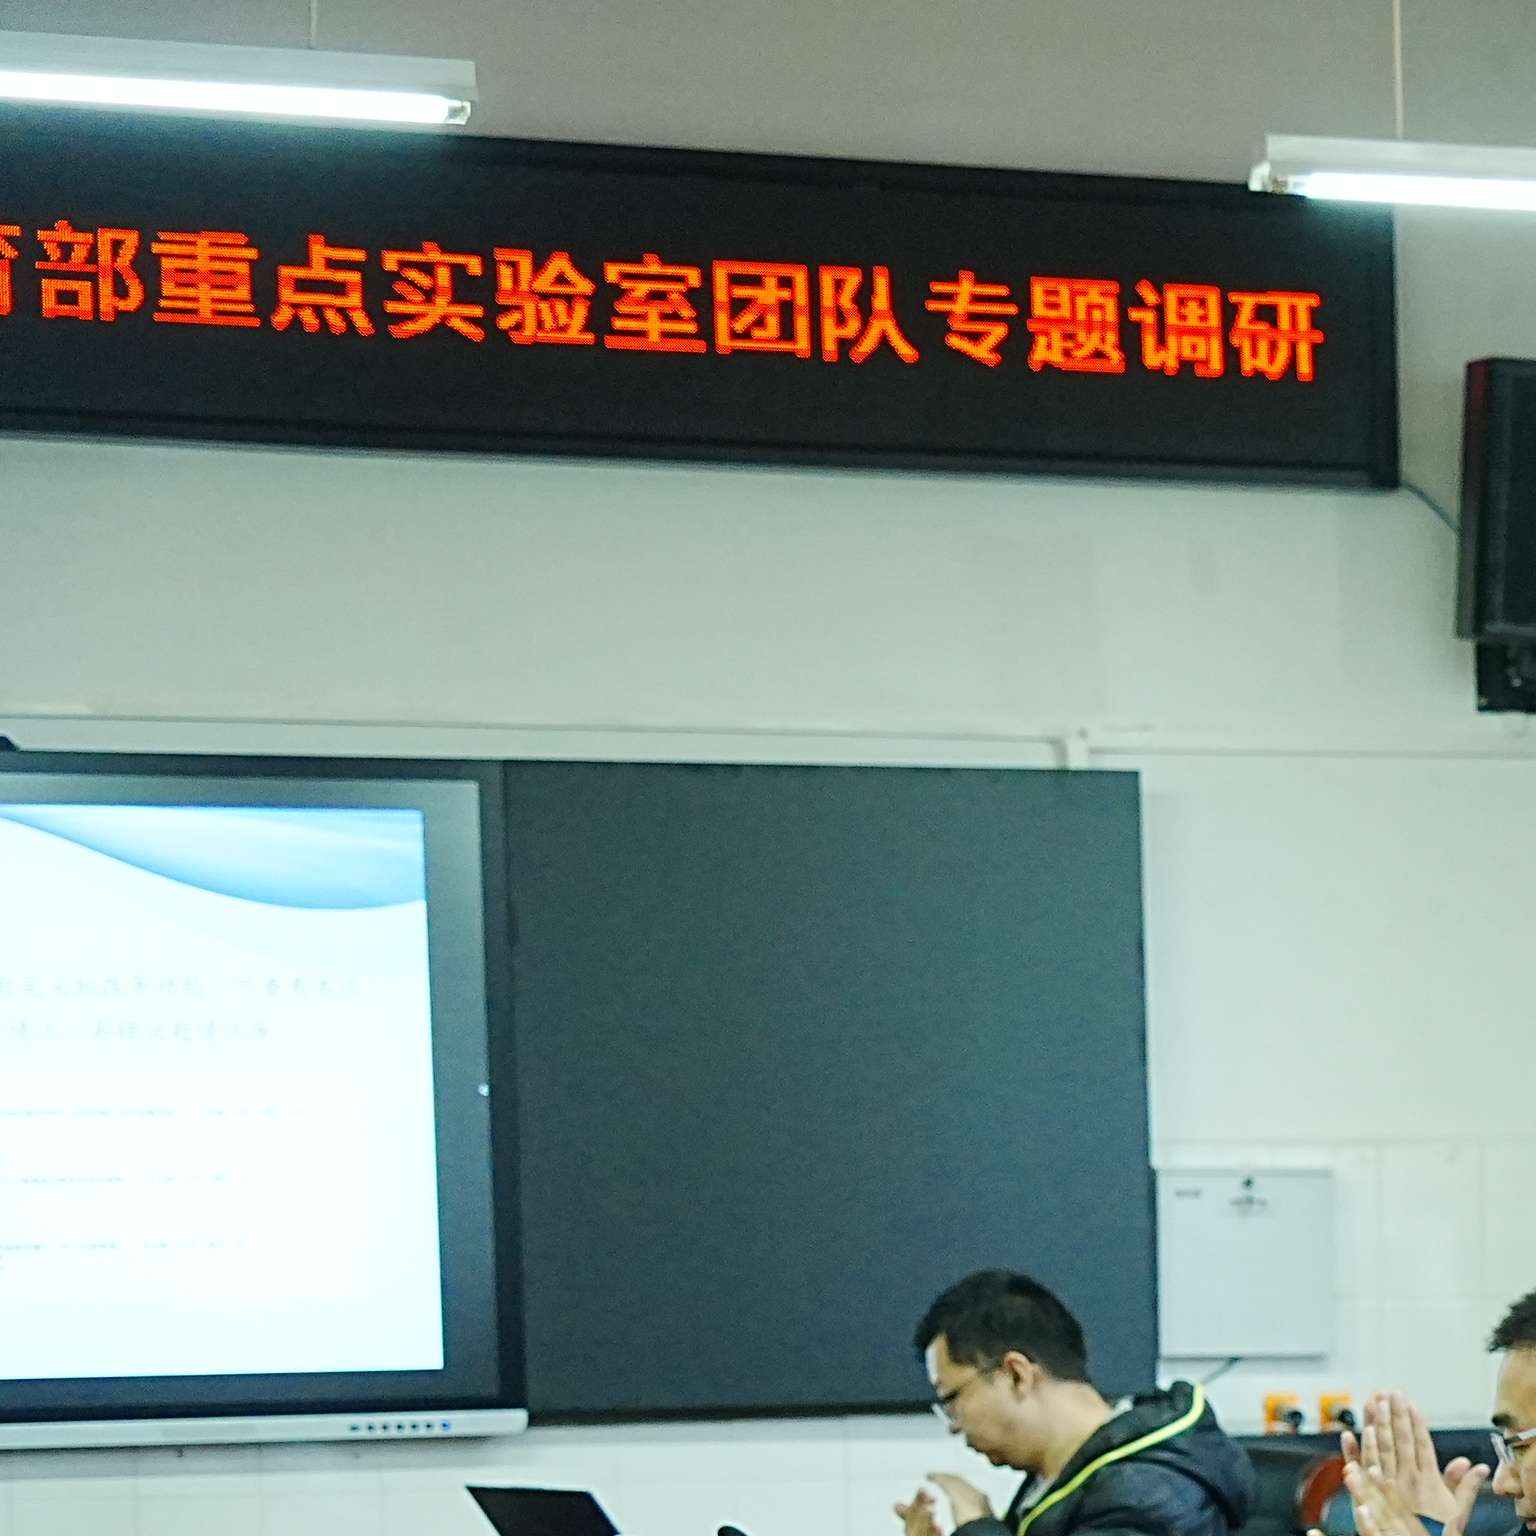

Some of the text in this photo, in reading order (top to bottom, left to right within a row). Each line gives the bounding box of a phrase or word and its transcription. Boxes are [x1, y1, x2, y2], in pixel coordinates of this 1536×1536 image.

[0, 220, 1324, 381] 部重点实验室团队专题调研
